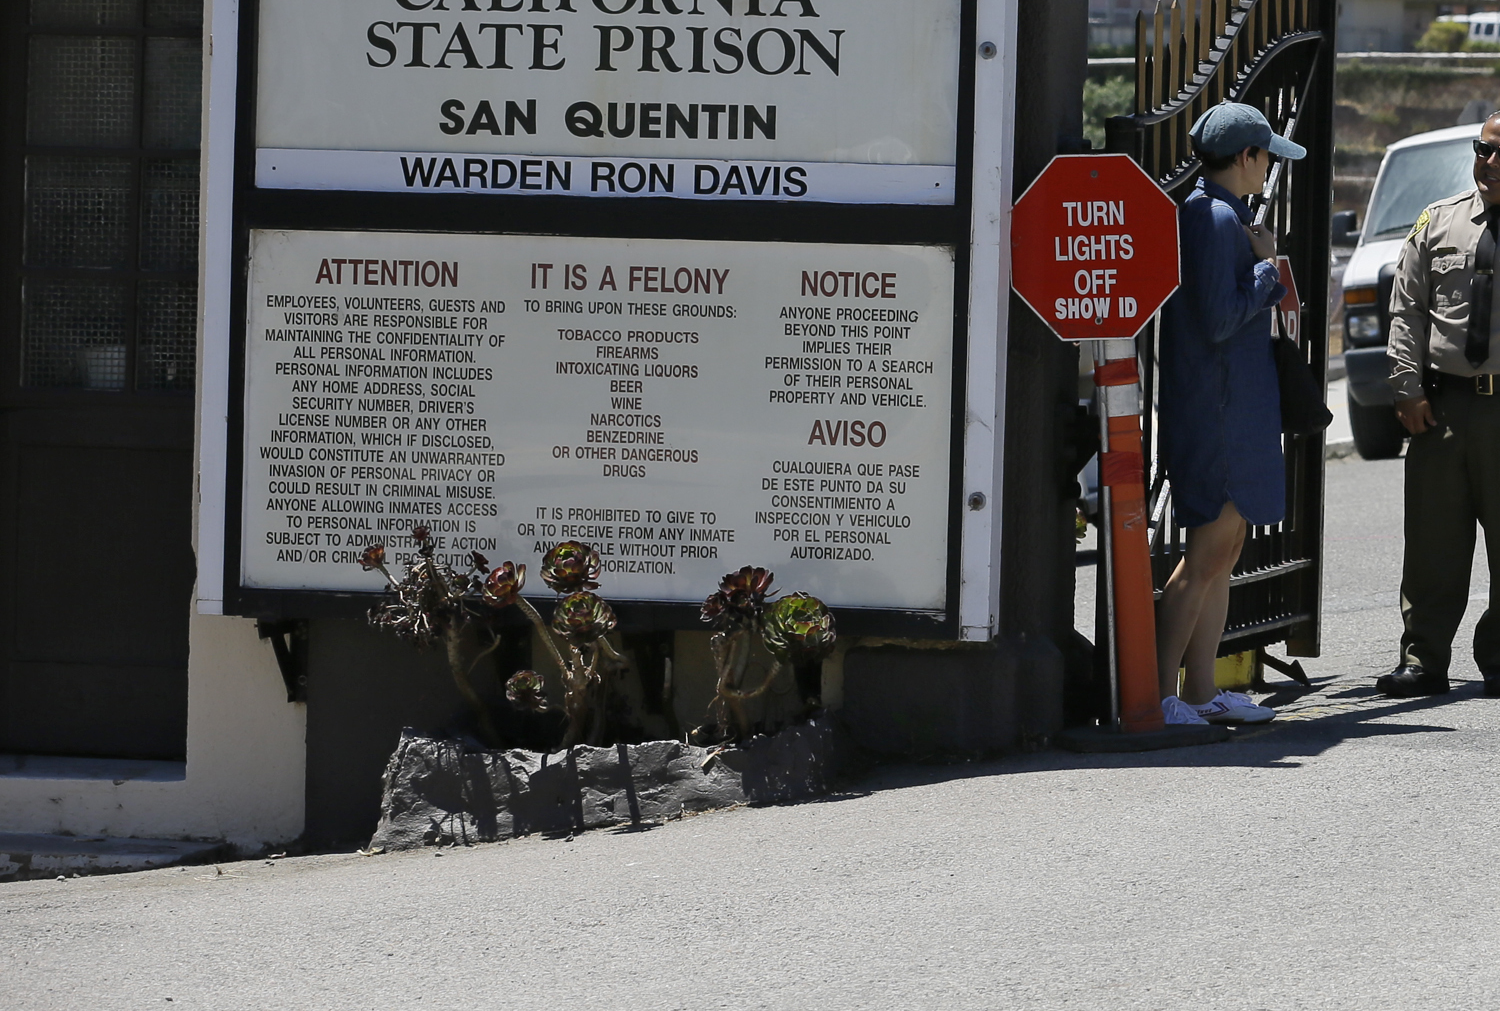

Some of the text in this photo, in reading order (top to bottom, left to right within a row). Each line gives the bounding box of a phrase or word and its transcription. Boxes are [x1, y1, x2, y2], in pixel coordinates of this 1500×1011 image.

[367, 21, 845, 77] STATE PRISON
[439, 98, 776, 140] SAN QUENTIN
[400, 156, 807, 198] WARDEN RON DAVIS
[1062, 200, 1125, 227] TURN
[1055, 234, 1134, 261] LIGHTS
[316, 258, 458, 288] ATTENTION
[532, 263, 729, 295] IT IS A FELONY
[1074, 269, 1117, 295] OFF
[801, 270, 896, 299] NOTICE
[267, 295, 506, 314] EMPLOYEES, VOLUNTEERS, GUESTS AND
[524, 299, 737, 319] TO BRING UPON THESE GROUNDS:
[1055, 297, 1137, 320] SHOW ID
[284, 312, 488, 330] VISITORS ARE RESPONSIBLE FOR
[780, 306, 919, 322] ANYONE PROCEEDING
[266, 329, 506, 348] MAINTAINING THE CONFIDENTIALITY OF
[558, 329, 699, 344] TOBACCO PRODUCTS
[785, 323, 911, 339] BEYOND THIS POINT
[294, 345, 476, 363] ALL PERSONAL INFORMATION.
[597, 345, 659, 360] FIREARMS
[803, 340, 892, 356] IMPLIES THEIR
[276, 362, 493, 381] PERSONAL INFORMATION INCLUDES
[556, 361, 699, 379] INTOXICATING LIQUORS
[765, 356, 934, 374] PERMISSION TO A SEARCH
[292, 379, 476, 398] ANY HOME ADDRESS, SOCIAL
[611, 379, 643, 393] BEER
[784, 374, 914, 390] OF THEIR PERSONAL
[293, 396, 475, 415] SECURITY NUMBER, DRIVER'S
[611, 397, 642, 410] WINE
[770, 390, 927, 408] PROPERTY AND VEHICLE.
[279, 413, 487, 432] LICENSE NUMBER OR ANY OTHER
[591, 413, 662, 428] NARCOTICS
[271, 430, 494, 450] INFORMATION, WHICH IF DISCLOSED,
[587, 430, 665, 445] BENZEDRINE
[808, 420, 886, 448] AVISO
[260, 446, 506, 466] WOULD CONSTITUTE AN UNWARRANTED
[553, 445, 699, 463] OR OTHER DANGEROUS
[270, 463, 495, 483] INVASION OF PERSONAL PRIVACY OR
[604, 464, 646, 478] DRUGS
[773, 461, 920, 478] CUALQUIERA QUE PASE
[269, 481, 496, 500] COULD RESULT IN CRIMINAL MISUSE.
[762, 478, 906, 495] DE ESTE PUNTO DA SU
[267, 498, 498, 517] ANYONE ALLOWING INMATES ACCESS
[772, 495, 896, 510] CONSENTIMIENTO A
[286, 515, 477, 533] TO PERSONAL INFORMATION IS
[537, 507, 717, 525] IT IS PROHIBITED TO GIVE TO
[756, 511, 911, 529] INSPECCION Y VEHICULO
[266, 531, 321, 546] SUBJECT
[325, 533, 342, 547] TO
[452, 537, 497, 553] ACTION
[518, 523, 735, 543] OR TO RECEIVE FROM ANY INMATE
[774, 528, 892, 545] POR EL PERSONAL
[277, 549, 327, 563] AND/OR
[332, 550, 389, 564] CRIML
[620, 543, 676, 558] WITHOUT
[681, 546, 718, 559] PRIOR
[790, 546, 875, 561] AUTORIZADO.
[597, 560, 675, 575] HORIZATION.
